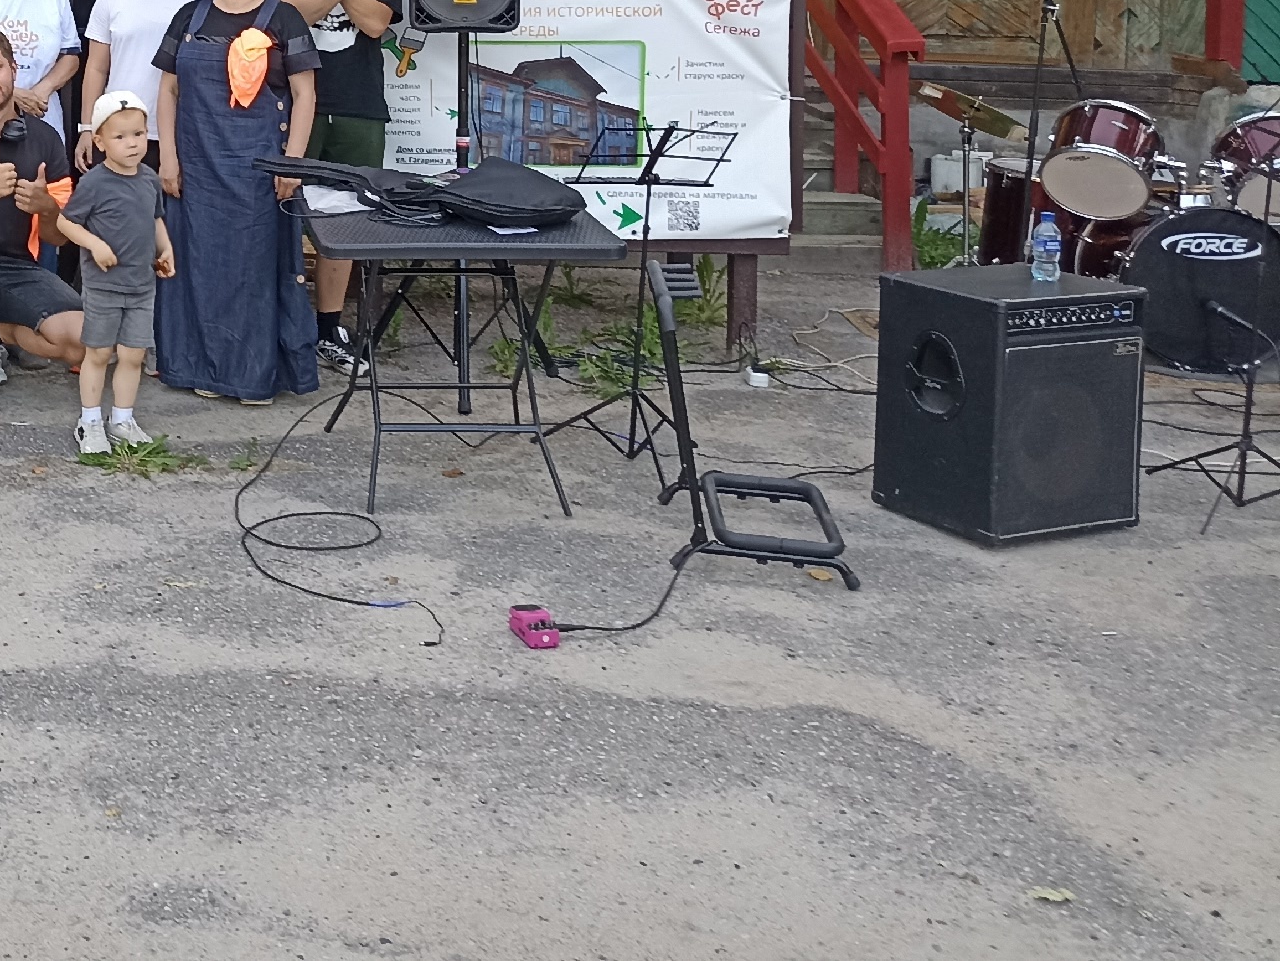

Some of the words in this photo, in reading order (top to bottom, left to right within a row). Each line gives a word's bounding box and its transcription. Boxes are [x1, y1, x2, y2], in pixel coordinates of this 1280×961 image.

[522, 6, 542, 18] ИЯ
[546, 4, 663, 18] ИСТОРИЧЕСКОЙ
[704, 21, 761, 38] Сегежа
[13, 44, 39, 58] ест
[684, 59, 725, 68] Зачистим
[697, 109, 735, 117] Нанесем
[696, 122, 739, 130] гртовку
[395, 145, 414, 154] Дом
[606, 190, 645, 198] сделать
[652, 192, 686, 200] еревод
[702, 192, 758, 200] материалы
[1175, 238, 1249, 254] FORCE
